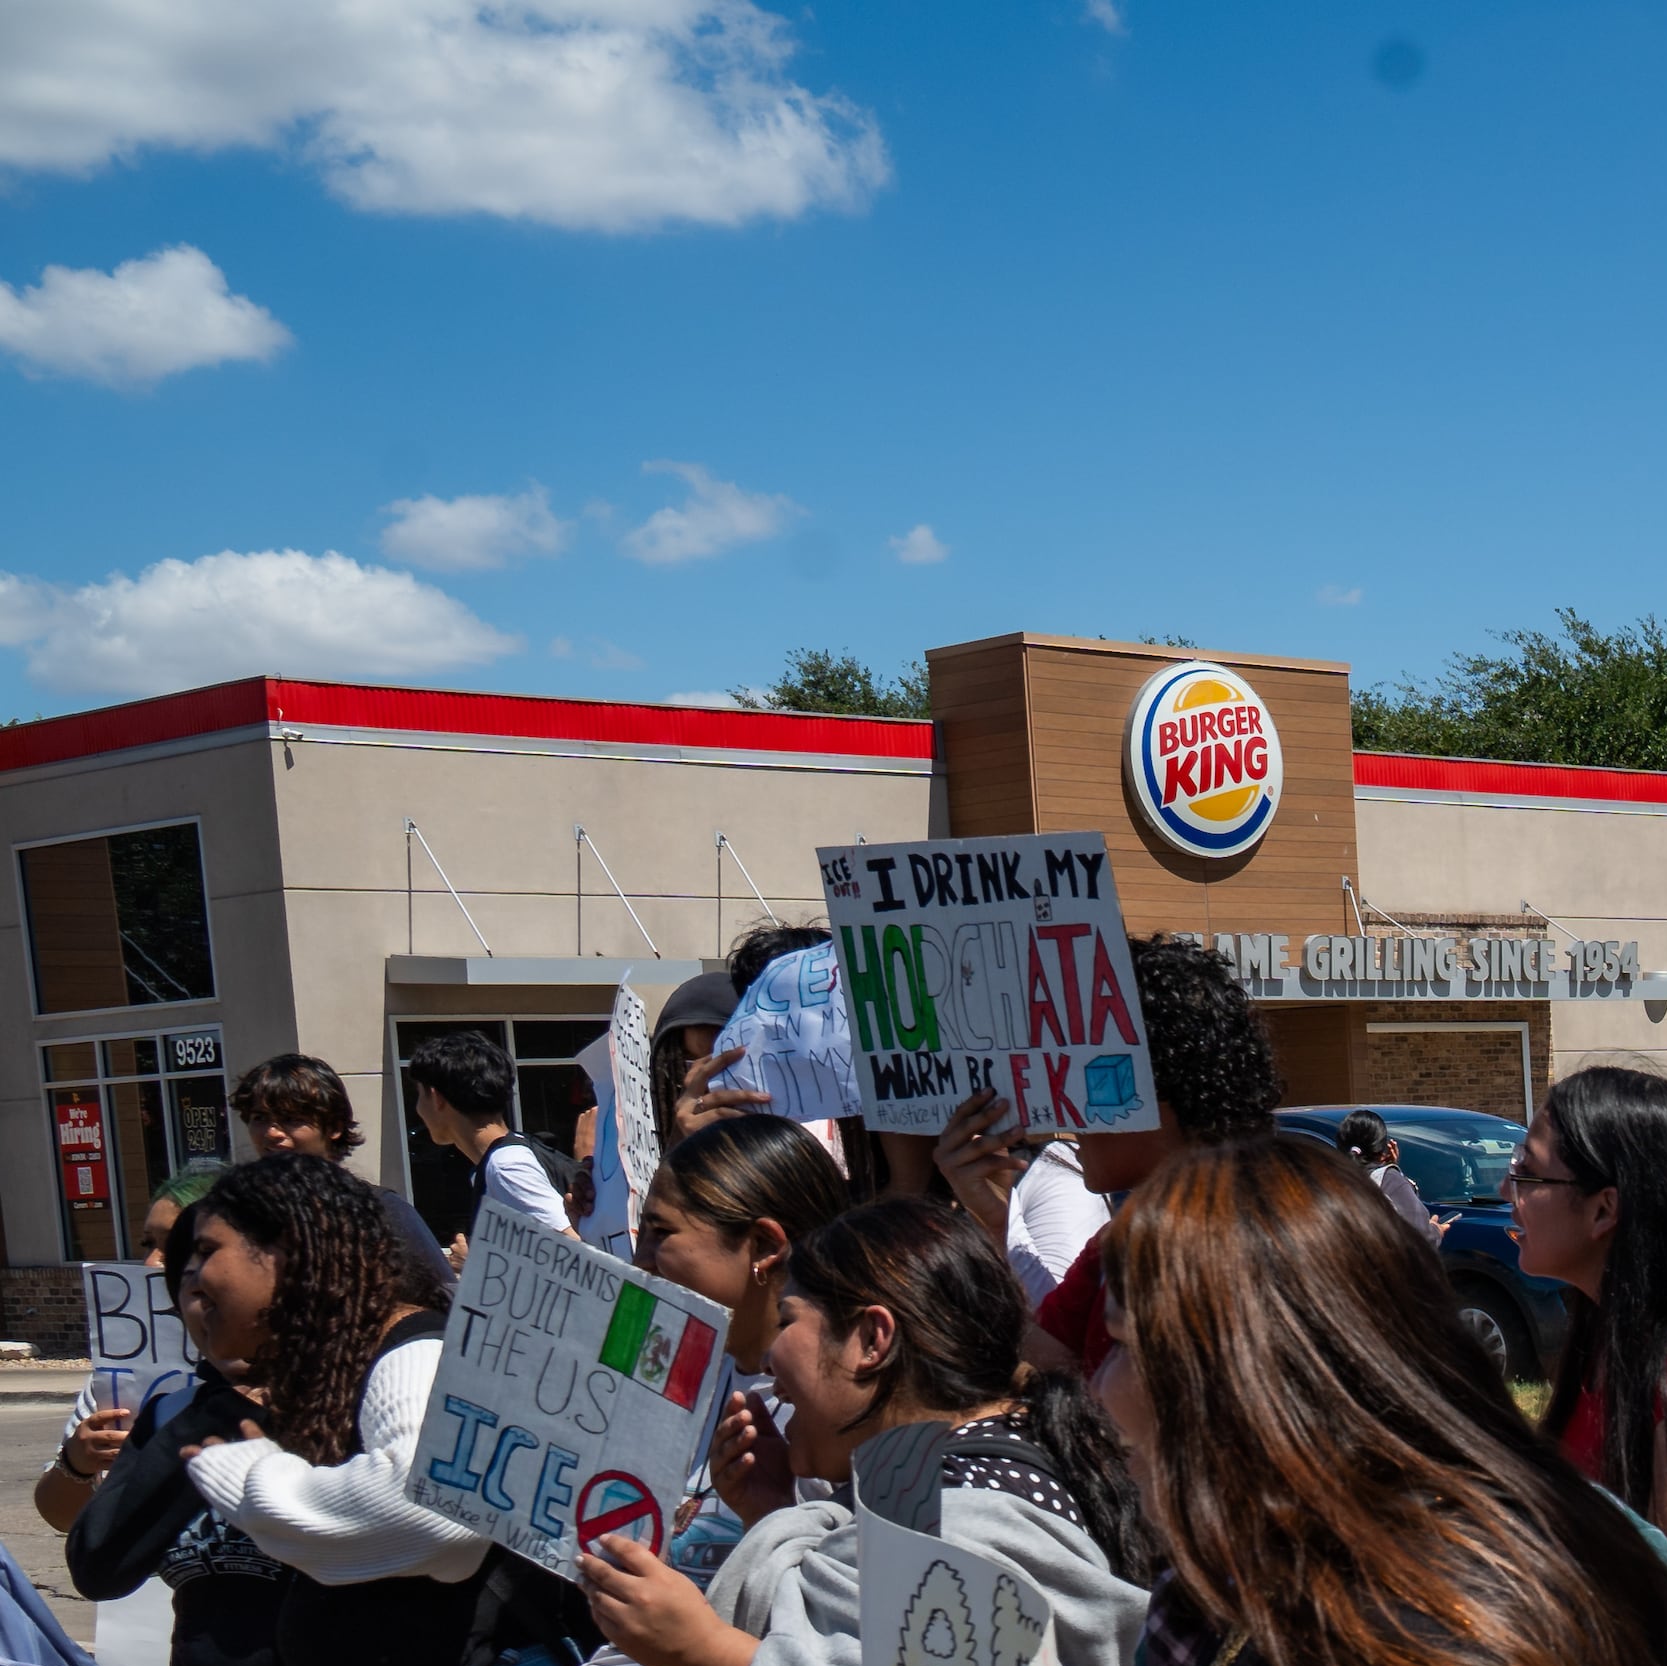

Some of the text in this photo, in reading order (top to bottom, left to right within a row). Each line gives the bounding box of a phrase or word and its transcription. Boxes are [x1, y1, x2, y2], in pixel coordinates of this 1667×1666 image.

[1159, 706, 1263, 757] BURGER
[1163, 736, 1268, 806] KING
[866, 849, 1105, 912] I DRINK MY
[840, 920, 1141, 1052] HORCHATA
[1170, 932, 1641, 983] AME GRILLING SINCE 1954
[175, 1036, 216, 1066] 9523
[772, 1014, 801, 1042] IN
[870, 1052, 958, 1101] WARM
[60, 1119, 101, 1149] Hiring
[184, 1106, 217, 1129] OPEN
[877, 1103, 930, 1126] #Justice
[479, 1208, 620, 1303] IMMIGRANTS
[90, 1269, 201, 1367] BR
[479, 1251, 581, 1339] BUILT
[460, 1305, 535, 1378] THE
[95, 1366, 199, 1430] IC
[428, 1393, 580, 1540] ICE
[412, 1478, 481, 1526] #Justice
[485, 1512, 499, 1535] 4
